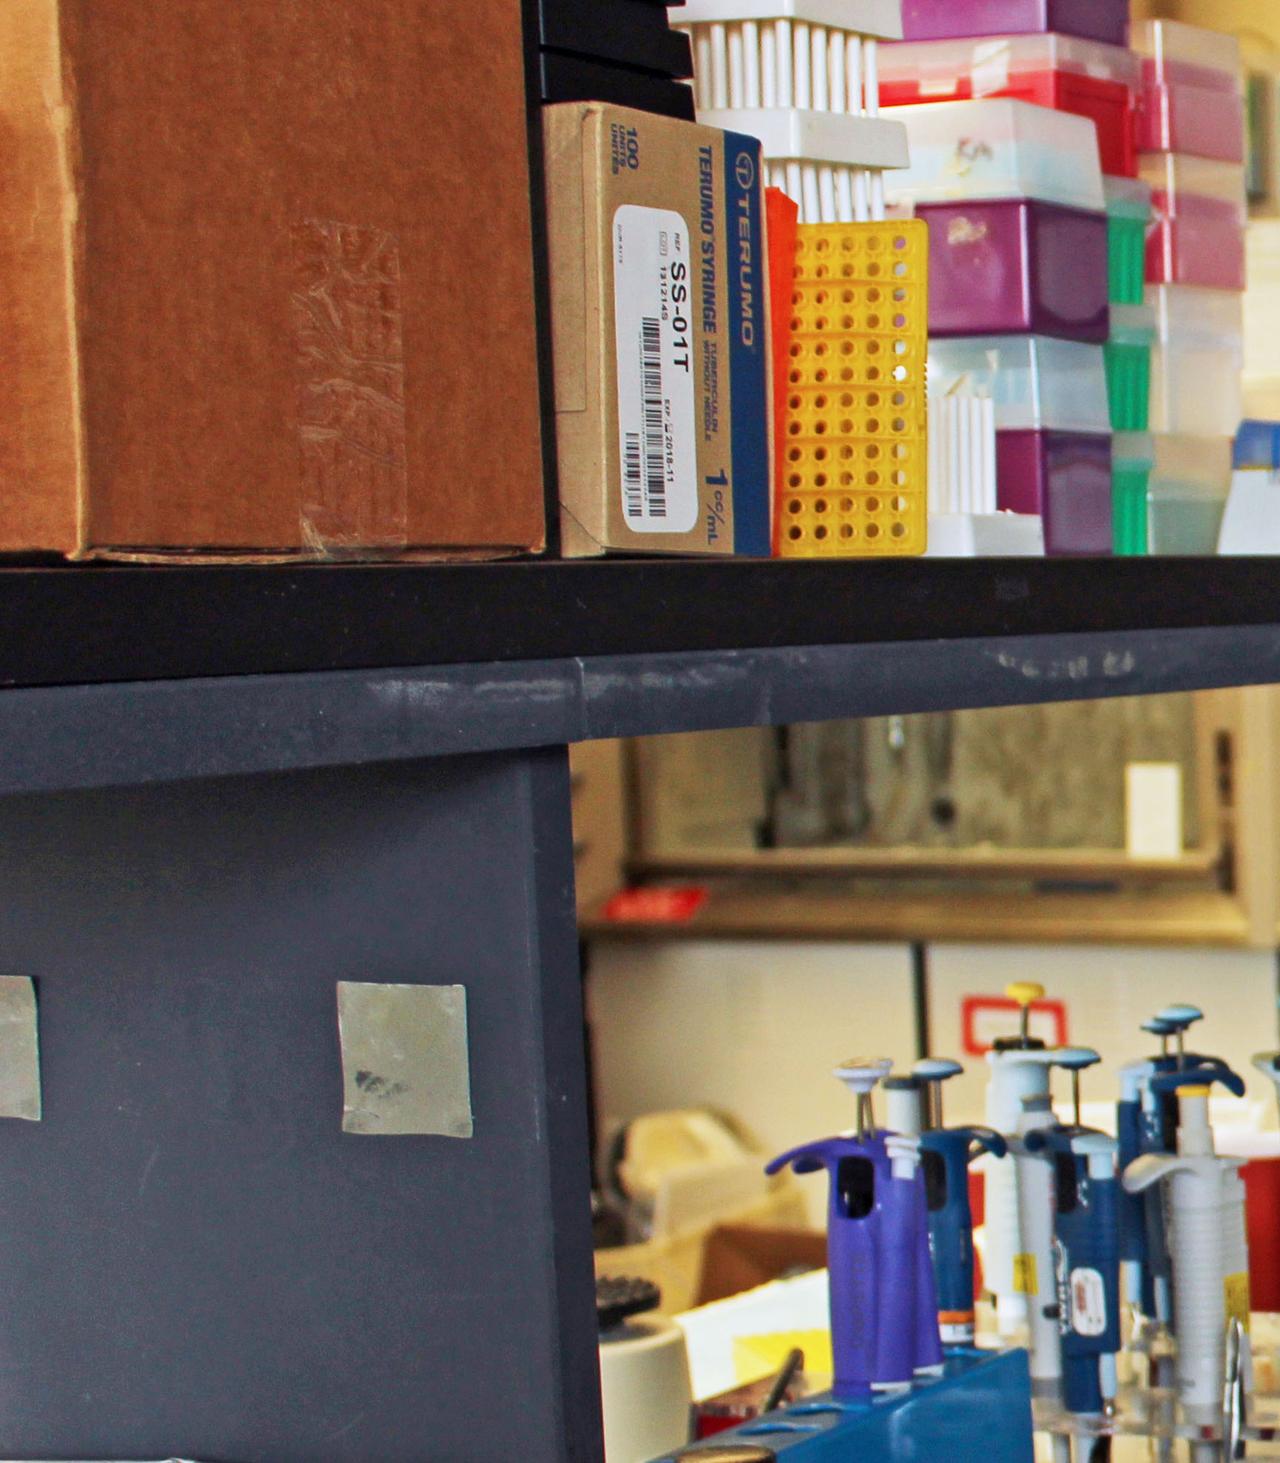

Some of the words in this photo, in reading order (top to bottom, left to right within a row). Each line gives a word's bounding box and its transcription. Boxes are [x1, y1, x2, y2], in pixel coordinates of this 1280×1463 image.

[627, 128, 639, 170] 100
[699, 145, 714, 235] TERUMO
[702, 240, 716, 333] SYRINGE
[737, 193, 754, 346] TERUMO
[671, 261, 689, 373] SS-01T
[703, 339, 711, 392] WITHOUT
[709, 341, 718, 433] TUBERCULIN
[704, 396, 712, 441] NEEDLE
[665, 435, 674, 482] 2018-11
[705, 468, 729, 486] 1
